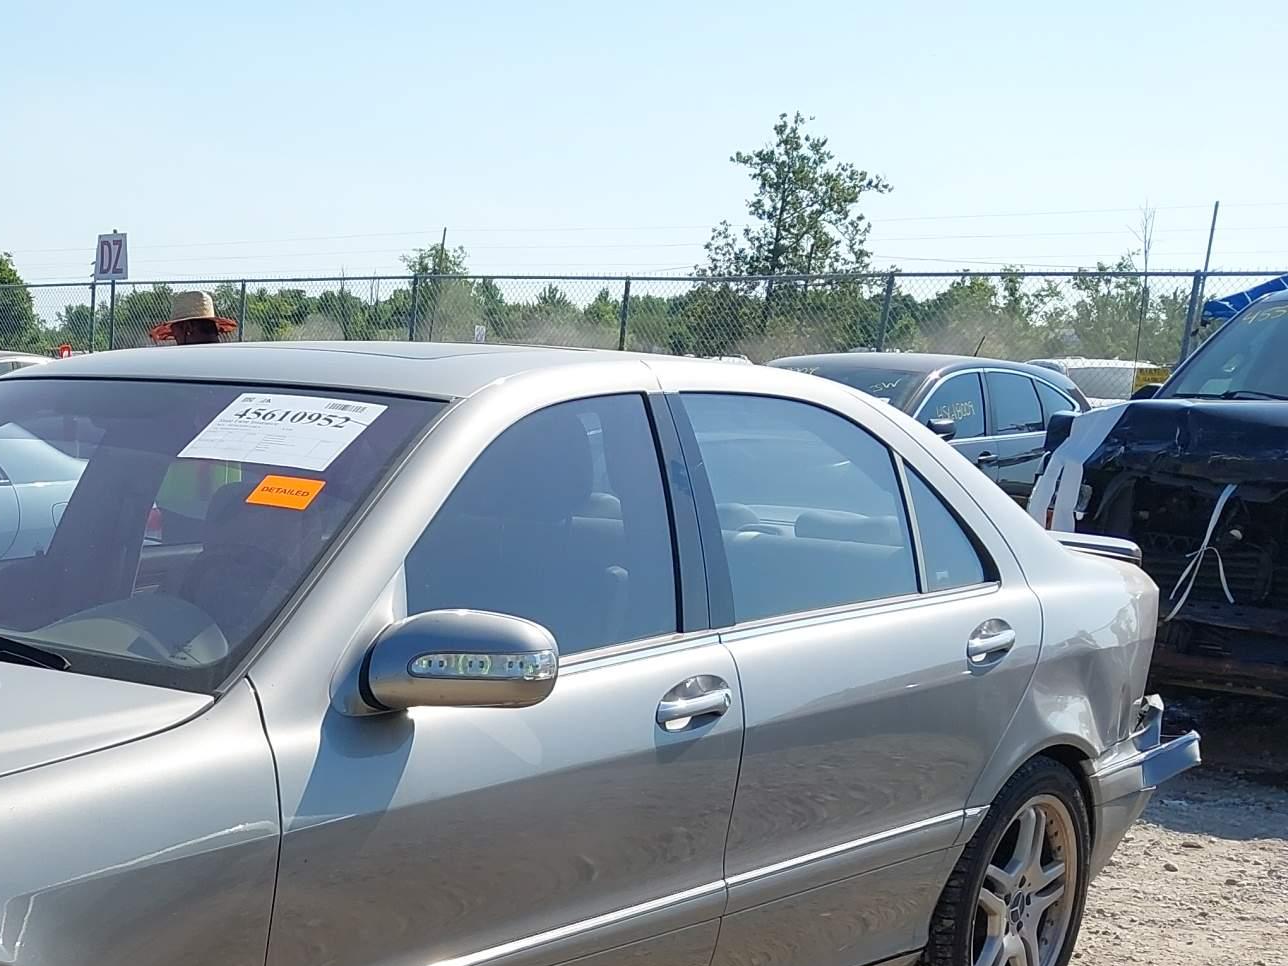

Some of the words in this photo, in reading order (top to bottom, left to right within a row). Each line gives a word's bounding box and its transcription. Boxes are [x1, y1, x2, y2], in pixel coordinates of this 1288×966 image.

[99, 239, 124, 275] DZ
[234, 407, 351, 429] 45610952
[261, 486, 310, 498] DETAILED
